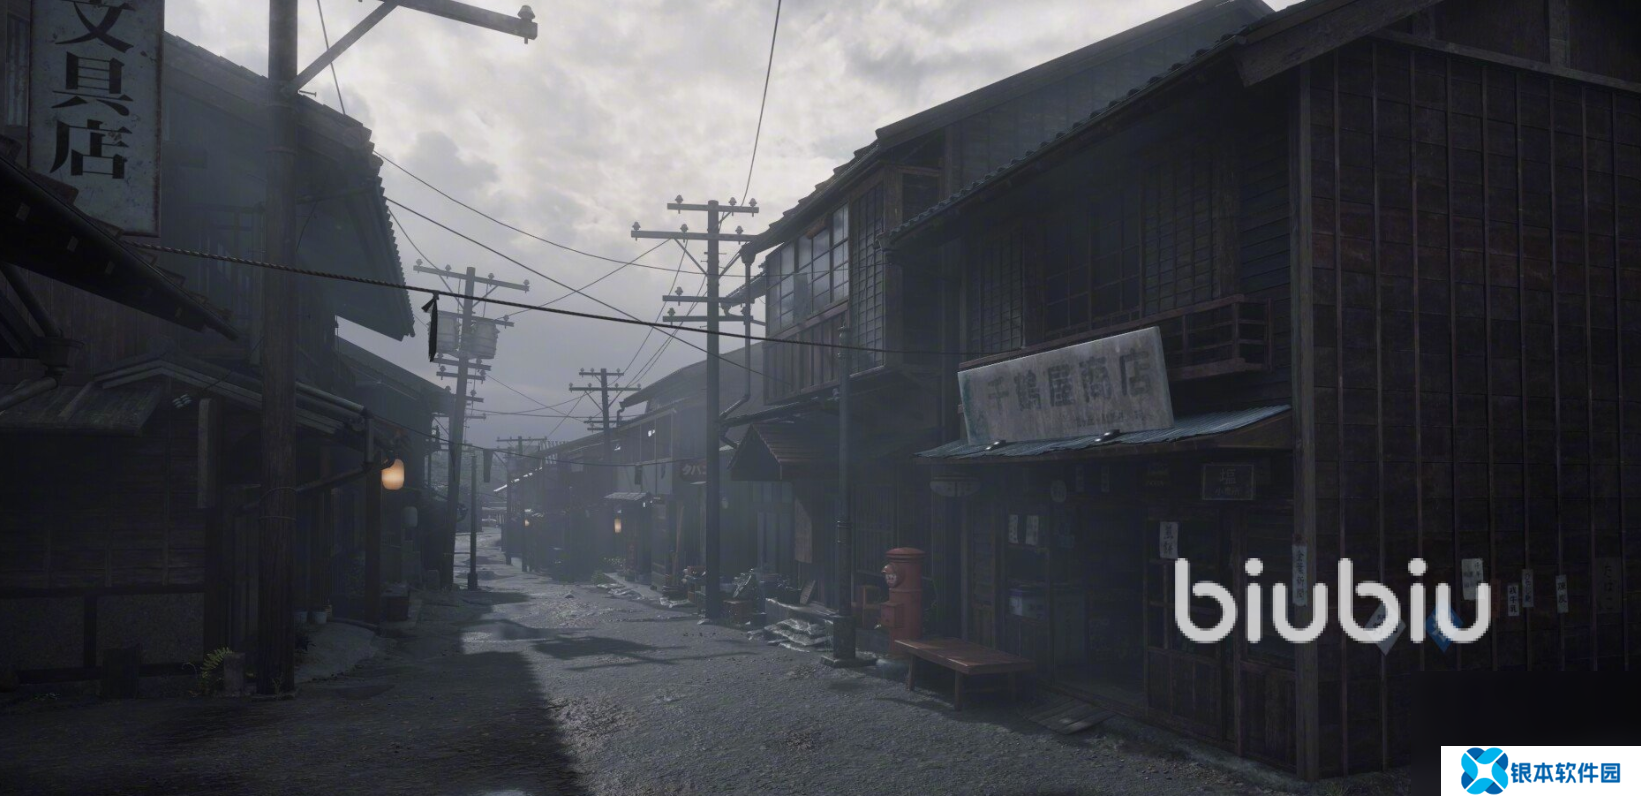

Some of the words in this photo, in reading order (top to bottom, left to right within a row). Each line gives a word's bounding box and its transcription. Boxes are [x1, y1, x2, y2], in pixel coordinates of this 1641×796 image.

[50, 0, 134, 179] 文具店
[988, 348, 1152, 414] 千鶴屋商店
[1220, 468, 1236, 485] 塩
